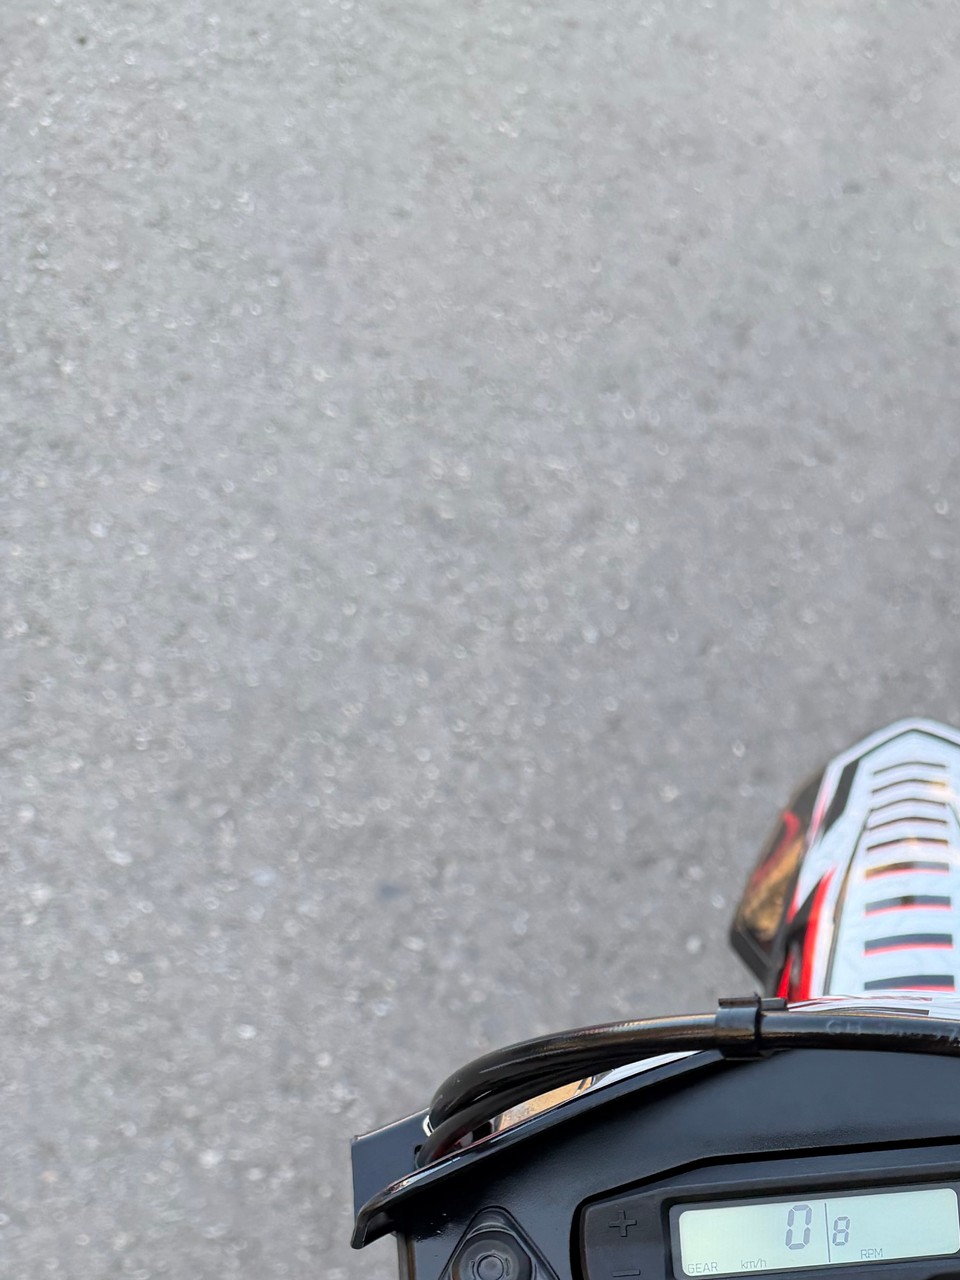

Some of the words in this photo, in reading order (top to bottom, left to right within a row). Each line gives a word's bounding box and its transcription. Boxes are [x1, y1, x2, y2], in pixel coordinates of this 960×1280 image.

[784, 1204, 813, 1250] 0
[832, 1216, 851, 1247] 8
[860, 1248, 884, 1259] RPM
[687, 1261, 718, 1274] GEAR
[740, 1257, 767, 1269] km/h
